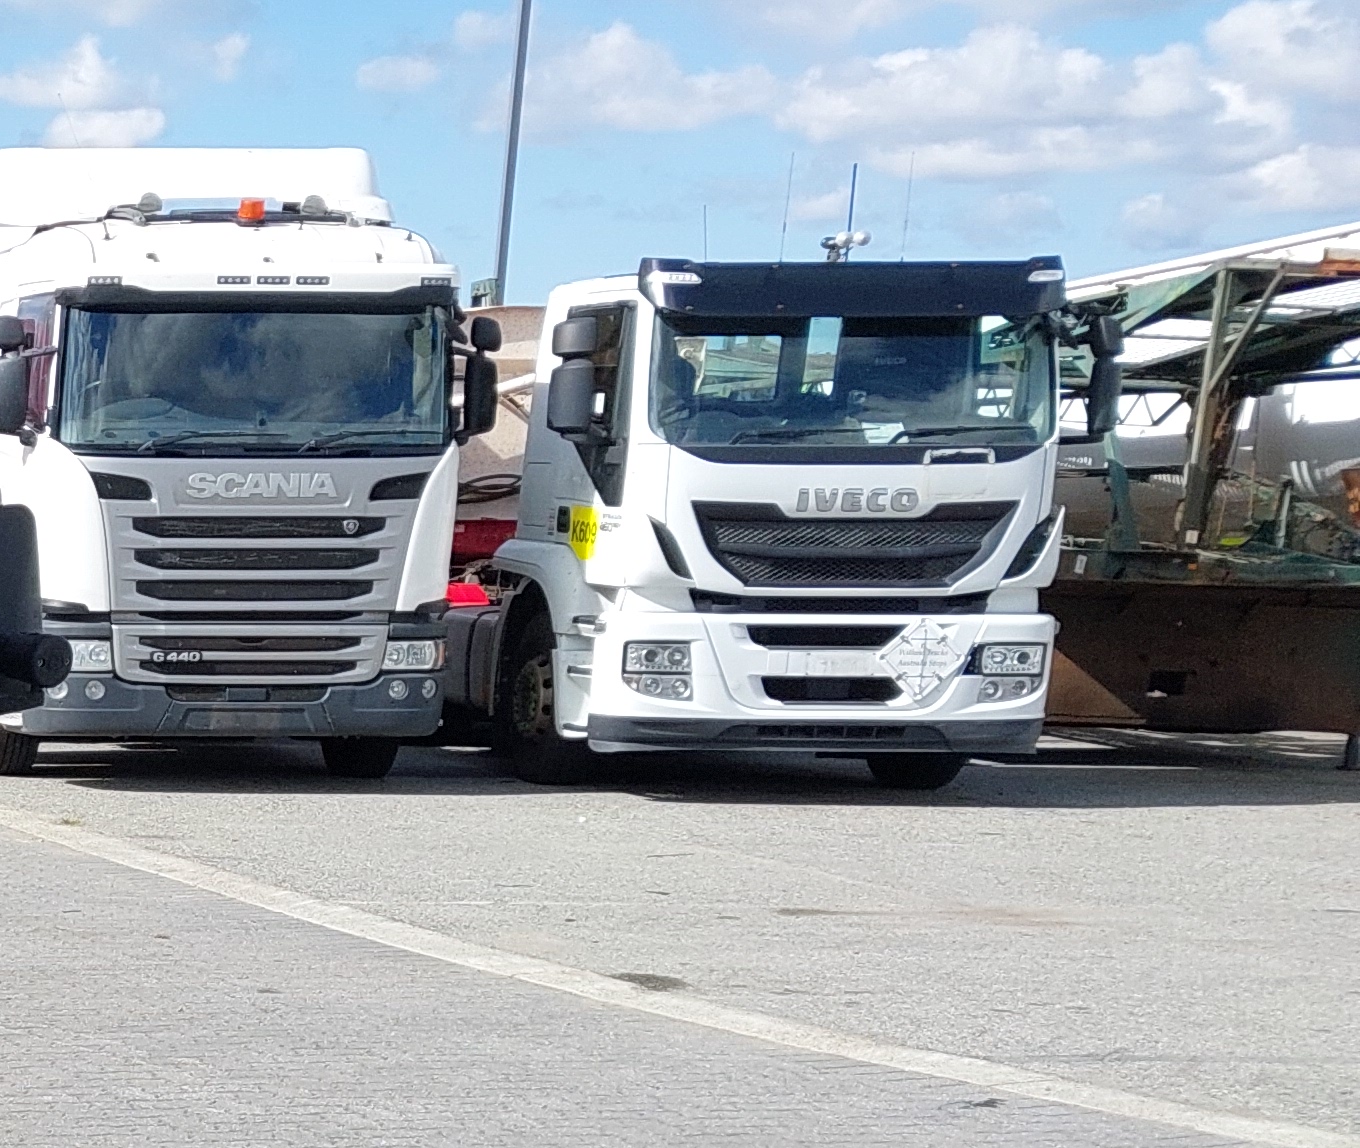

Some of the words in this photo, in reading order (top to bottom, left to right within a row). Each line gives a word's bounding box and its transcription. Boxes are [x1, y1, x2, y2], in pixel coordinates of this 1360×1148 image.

[186, 472, 337, 499] SCANIA
[796, 488, 919, 512] IVECO
[571, 520, 597, 544] K609
